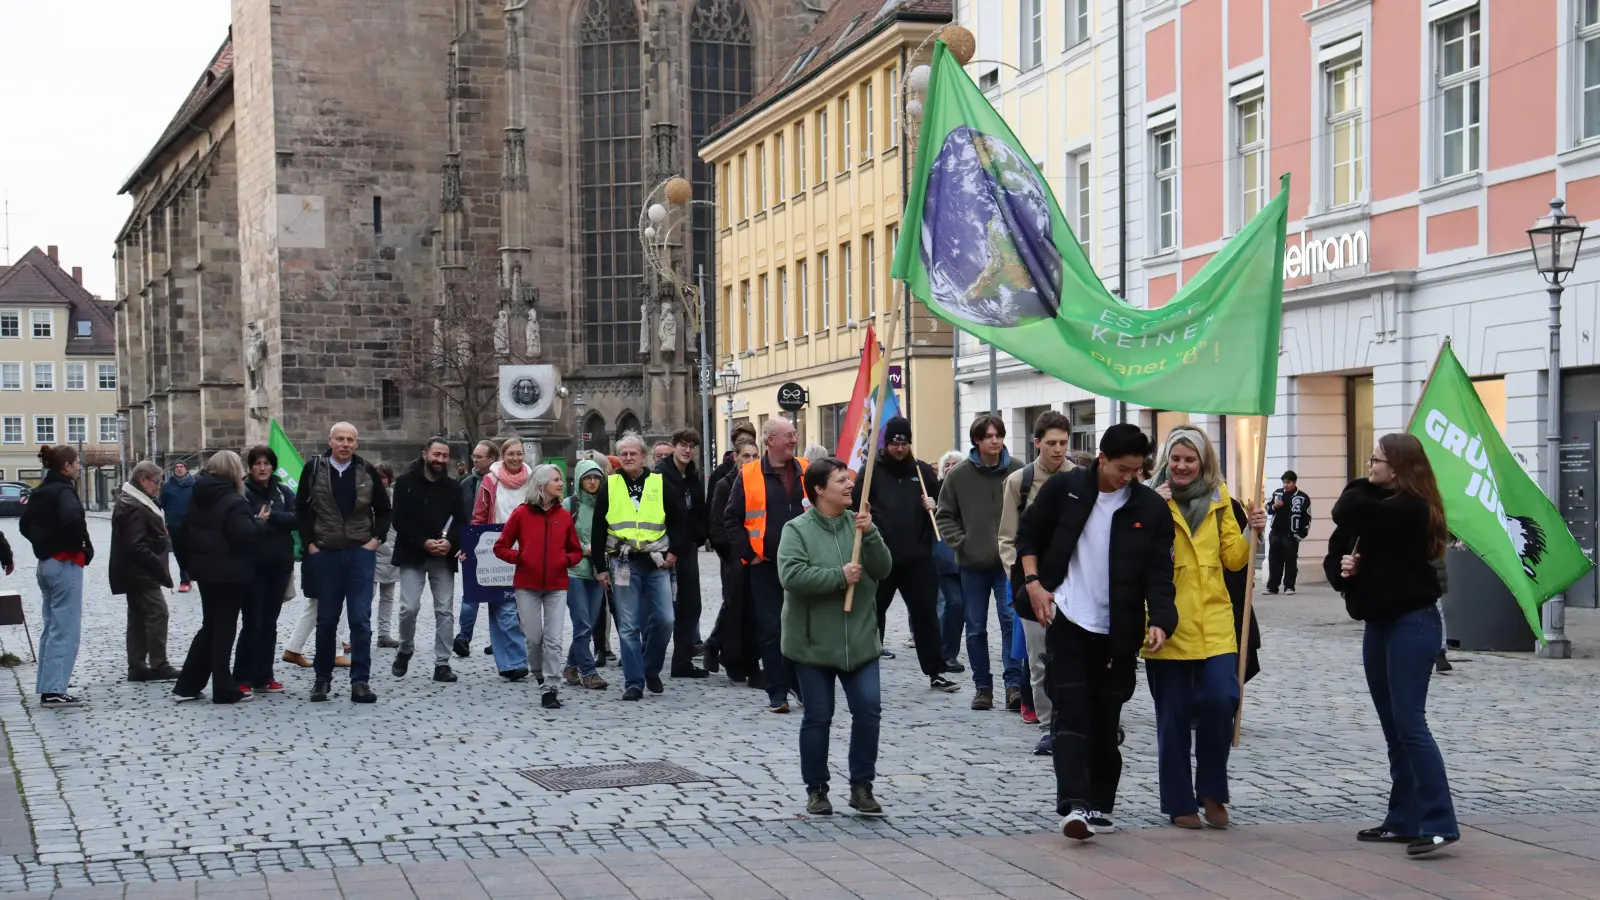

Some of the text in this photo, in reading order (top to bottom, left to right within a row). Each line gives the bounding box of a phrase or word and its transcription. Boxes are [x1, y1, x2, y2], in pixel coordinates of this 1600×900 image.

[1100, 308, 1134, 329] ES
[1582, 329, 1590, 345] 8
[889, 373, 901, 383] rty
[1425, 408, 1493, 481] GRÜ
